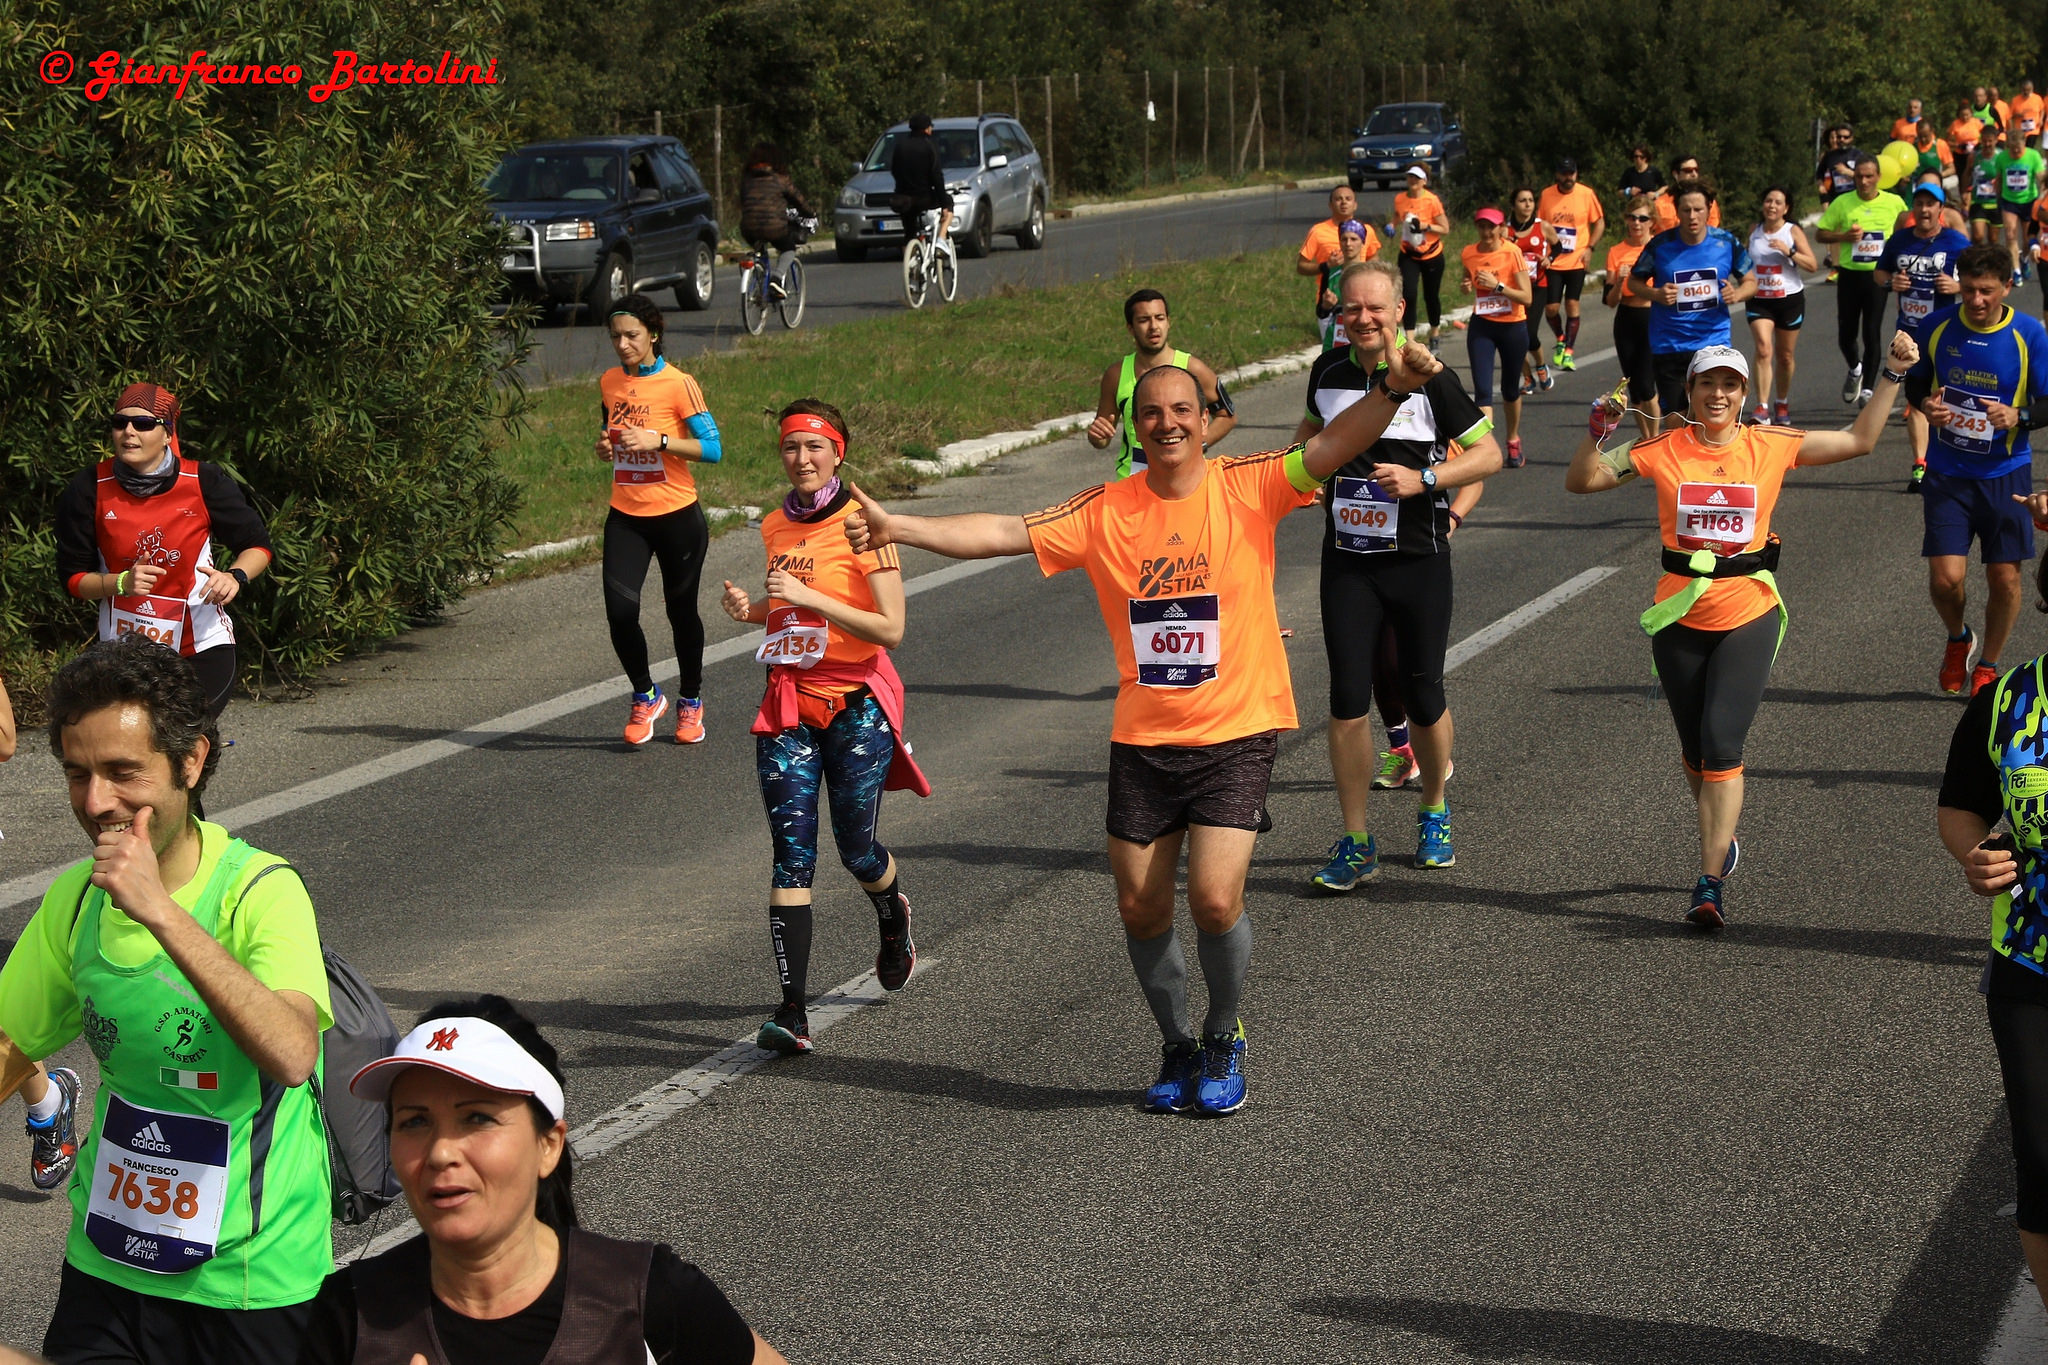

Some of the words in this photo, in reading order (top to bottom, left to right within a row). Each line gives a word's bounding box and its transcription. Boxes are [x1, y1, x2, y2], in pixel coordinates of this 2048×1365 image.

[1683, 285, 1711, 297] 8140
[616, 450, 658, 465] F2153
[1340, 507, 1388, 529] 9049
[1686, 514, 1744, 533] F1168
[768, 554, 814, 572] ROMA
[1140, 552, 1209, 580] ROMA
[1138, 574, 1206, 598] OSTIA
[135, 618, 154, 626] SERENA
[760, 636, 820, 660] F2136
[1150, 632, 1204, 654] 6071
[174, 1006, 213, 1035] AMATORI
[163, 1046, 208, 1063] CASERTA
[131, 1137, 172, 1153] adidas
[123, 1157, 179, 1177] FRANCESCO
[108, 1162, 199, 1220] 7638
[125, 1234, 159, 1251] ROMA
